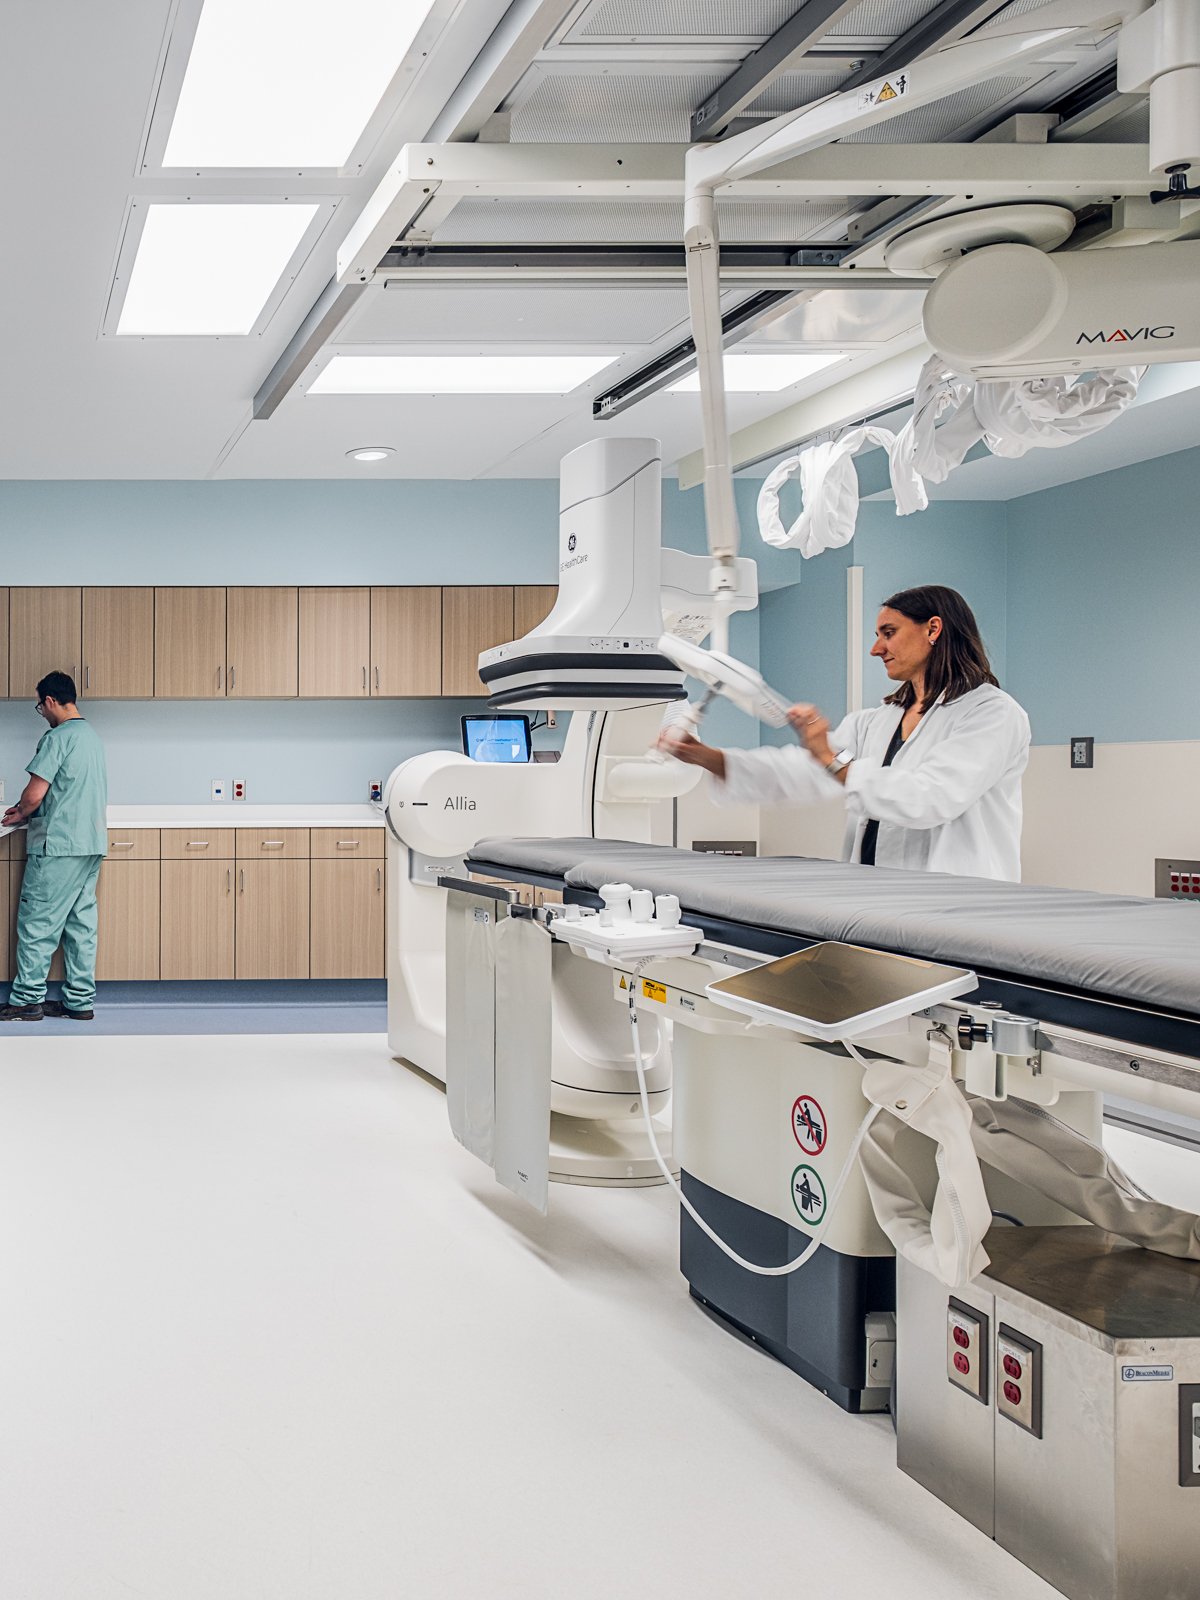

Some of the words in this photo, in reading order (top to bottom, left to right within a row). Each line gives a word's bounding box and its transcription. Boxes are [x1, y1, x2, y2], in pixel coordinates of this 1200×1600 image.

[1076, 326, 1175, 344] MAVIG
[564, 554, 588, 569] HealthCare
[444, 796, 477, 811] Allia
